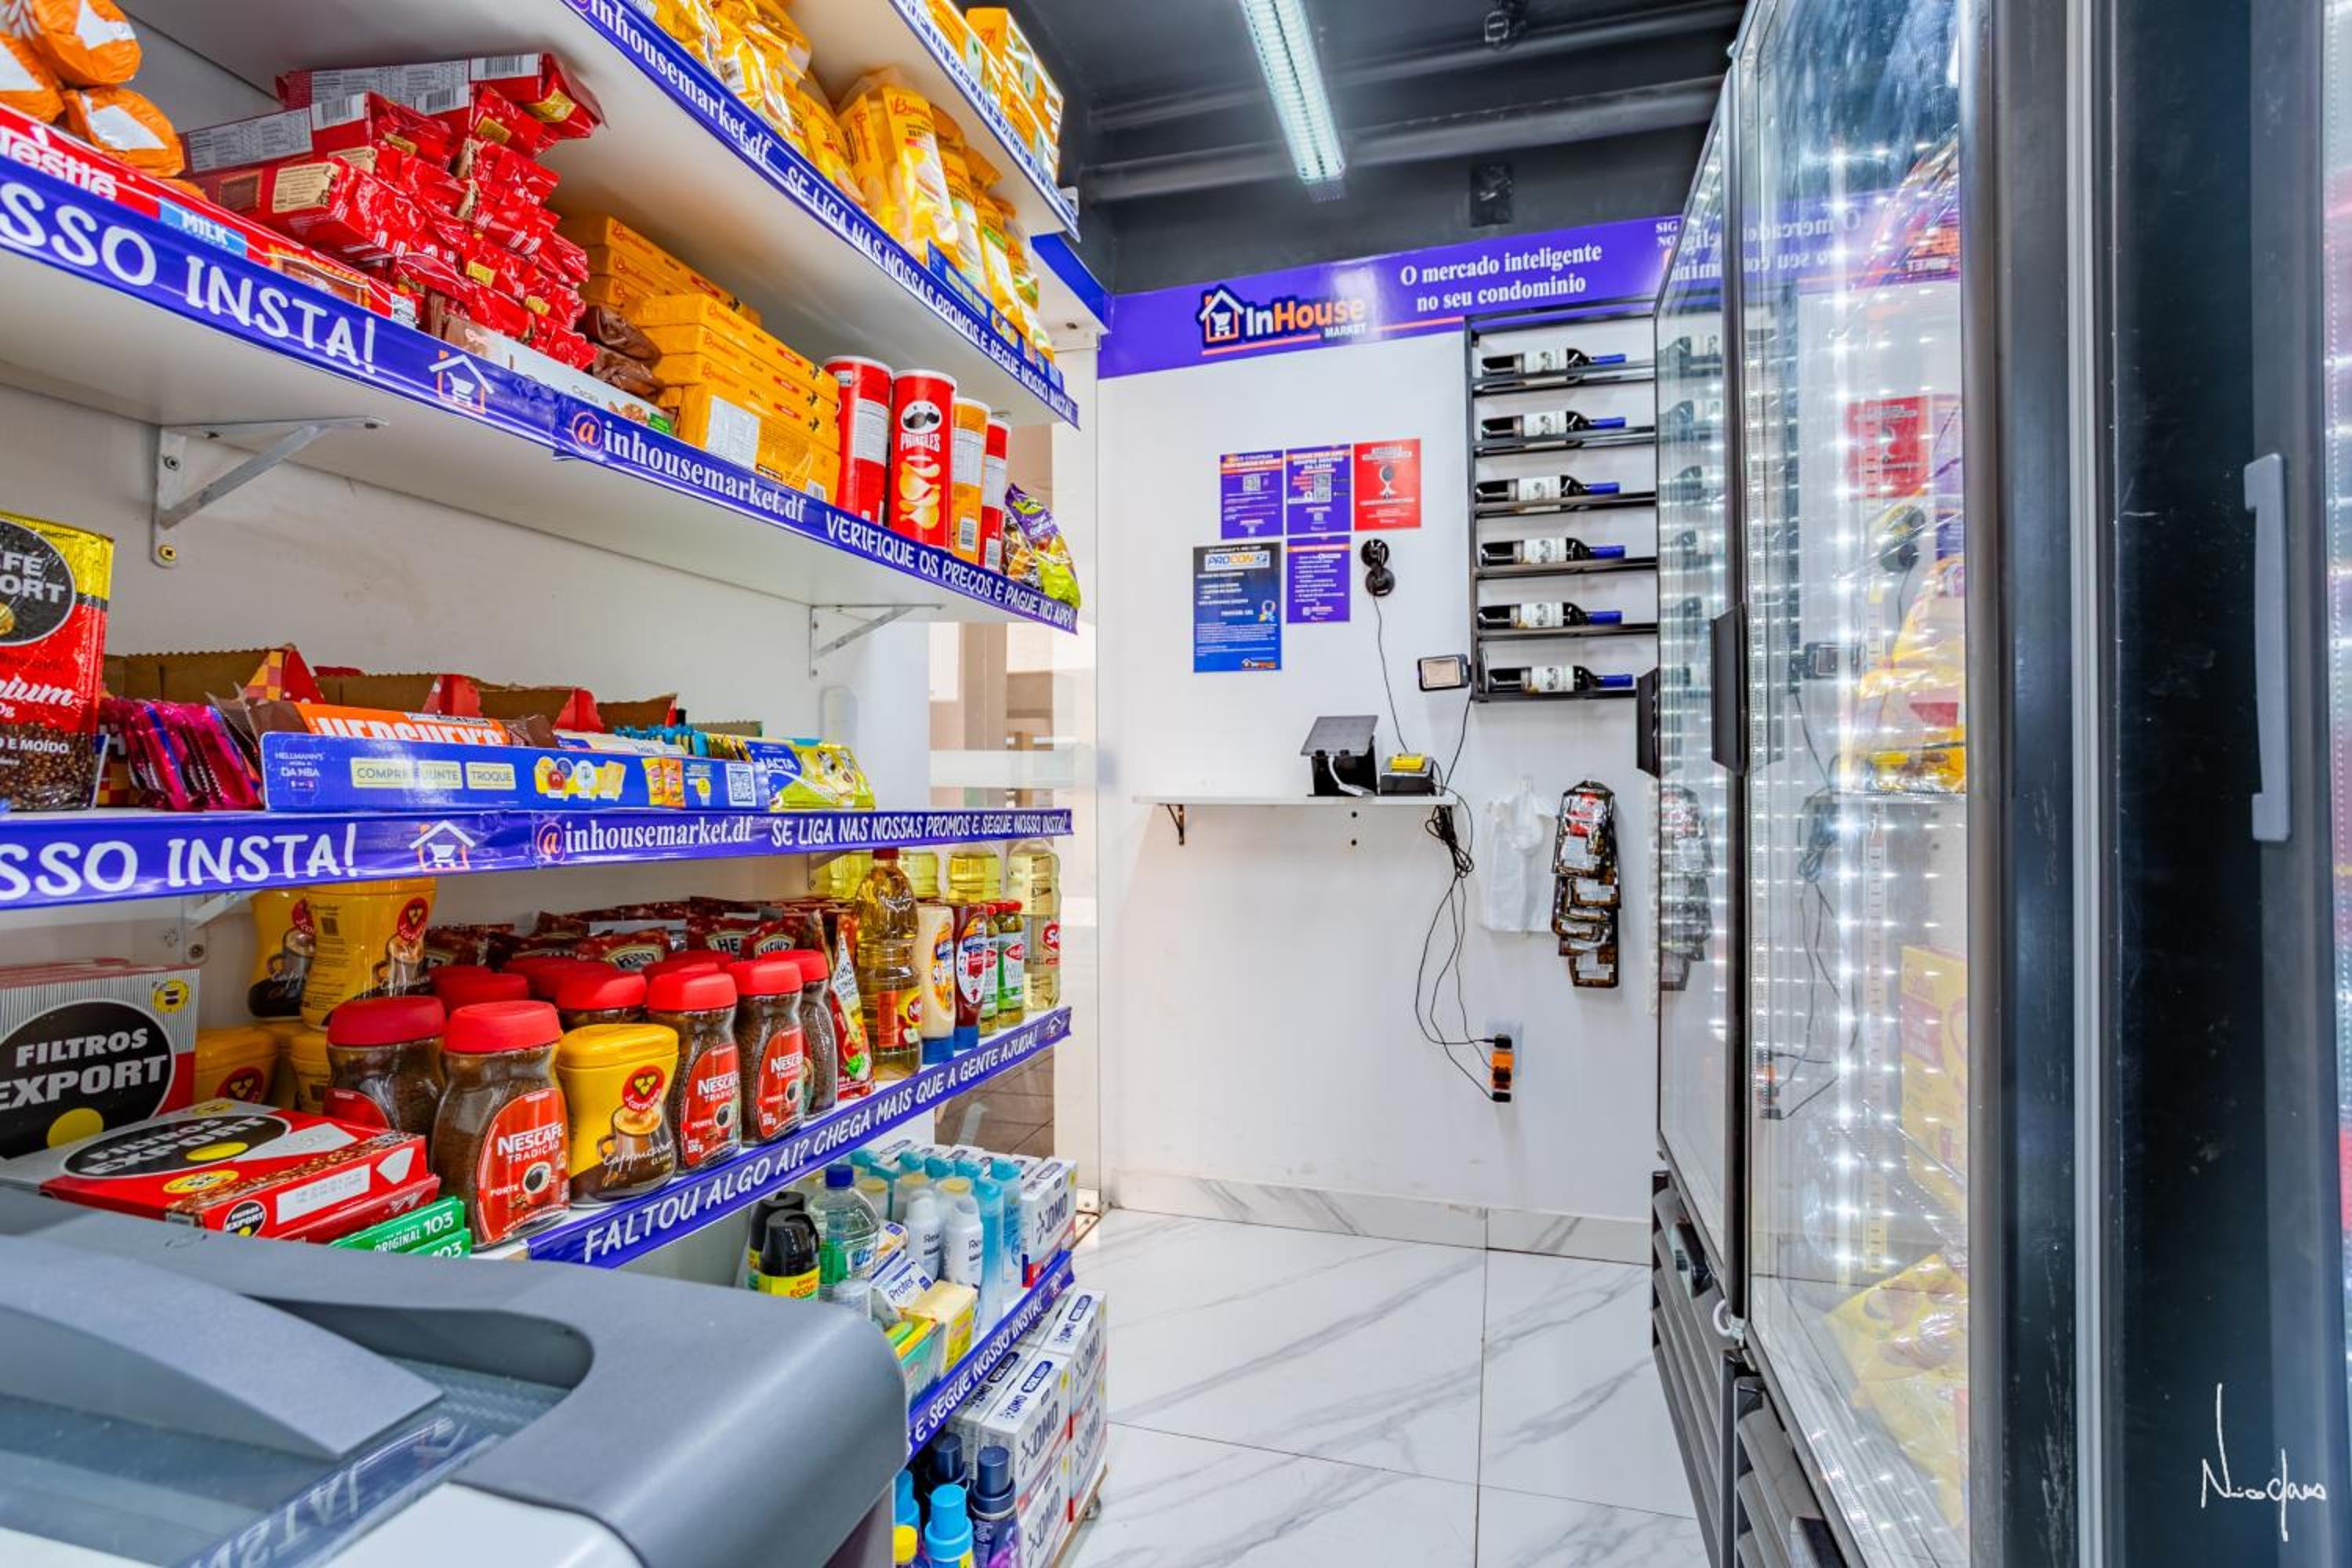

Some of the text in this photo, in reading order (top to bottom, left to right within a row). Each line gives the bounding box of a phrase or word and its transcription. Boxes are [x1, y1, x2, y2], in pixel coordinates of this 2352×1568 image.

[181, 211, 232, 246] MILK
[786, 166, 808, 196] SE
[813, 183, 848, 233] LIGA
[853, 223, 882, 265] NAS
[884, 251, 934, 307] NOSSAS
[936, 294, 978, 344] PROMOS
[980, 333, 989, 353] E
[990, 339, 1019, 378] SEGUE
[1400, 243, 1603, 286] O mercado inteligente
[185, 255, 376, 374] INSTA!
[1246, 298, 1367, 337] InHouse
[1417, 296, 1439, 312] no
[1443, 291, 1472, 309] seu
[1324, 322, 1367, 339] MARKET
[899, 431, 941, 453] PRINGLES
[572, 412, 807, 523] @inhousemarket.df
[825, 510, 916, 569] VERIFIQUE
[919, 553, 939, 578] OS
[943, 560, 993, 598] PREÇOS
[994, 580, 1004, 601] E
[1005, 585, 1038, 616] PAGUE
[1039, 600, 1053, 620] NO
[1207, 553, 1254, 566] PROCON
[20, 739, 71, 753] MOÍDO
[424, 768, 459, 781] JUNTE
[470, 770, 513, 782] TROQUE
[166, 822, 358, 887] INSTA!
[537, 815, 753, 863] @inhousemarket.df
[771, 818, 793, 848] SE
[798, 817, 834, 846] LIGA
[838, 816, 868, 843] NAS
[872, 815, 923, 841] NOSSAS
[925, 814, 970, 838] PROMOS
[971, 815, 981, 835] E
[982, 815, 1013, 834] SEGUE
[1014, 814, 1041, 833] NOSSO
[15, 1028, 148, 1068] FILTROS
[0, 1054, 168, 1111] EXPORT
[78, 1116, 268, 1175] EXPORT
[87, 1119, 223, 1160] FILTROS
[497, 1121, 564, 1156] NESCAFÉ
[507, 1141, 560, 1164] TRADIÇÃO
[585, 1186, 700, 1263] FALTOU
[706, 1160, 771, 1210] ALGO
[814, 1111, 872, 1154] CHEGA
[876, 1091, 912, 1127] MAIS
[915, 1073, 946, 1105] QUE
[947, 1067, 957, 1089] A
[960, 1049, 999, 1083] GENTE
[1000, 1025, 1039, 1062] AJUDA!
[489, 1183, 520, 1197] FORTE
[225, 1212, 265, 1232] EXPORT
[423, 1211, 455, 1236] 103
[374, 1229, 422, 1253] ORIGINAL
[888, 1275, 915, 1301] Protex
[915, 1415, 927, 1443] E
[928, 1372, 973, 1428] SEGUE
[973, 1332, 1011, 1384] NOSSO
